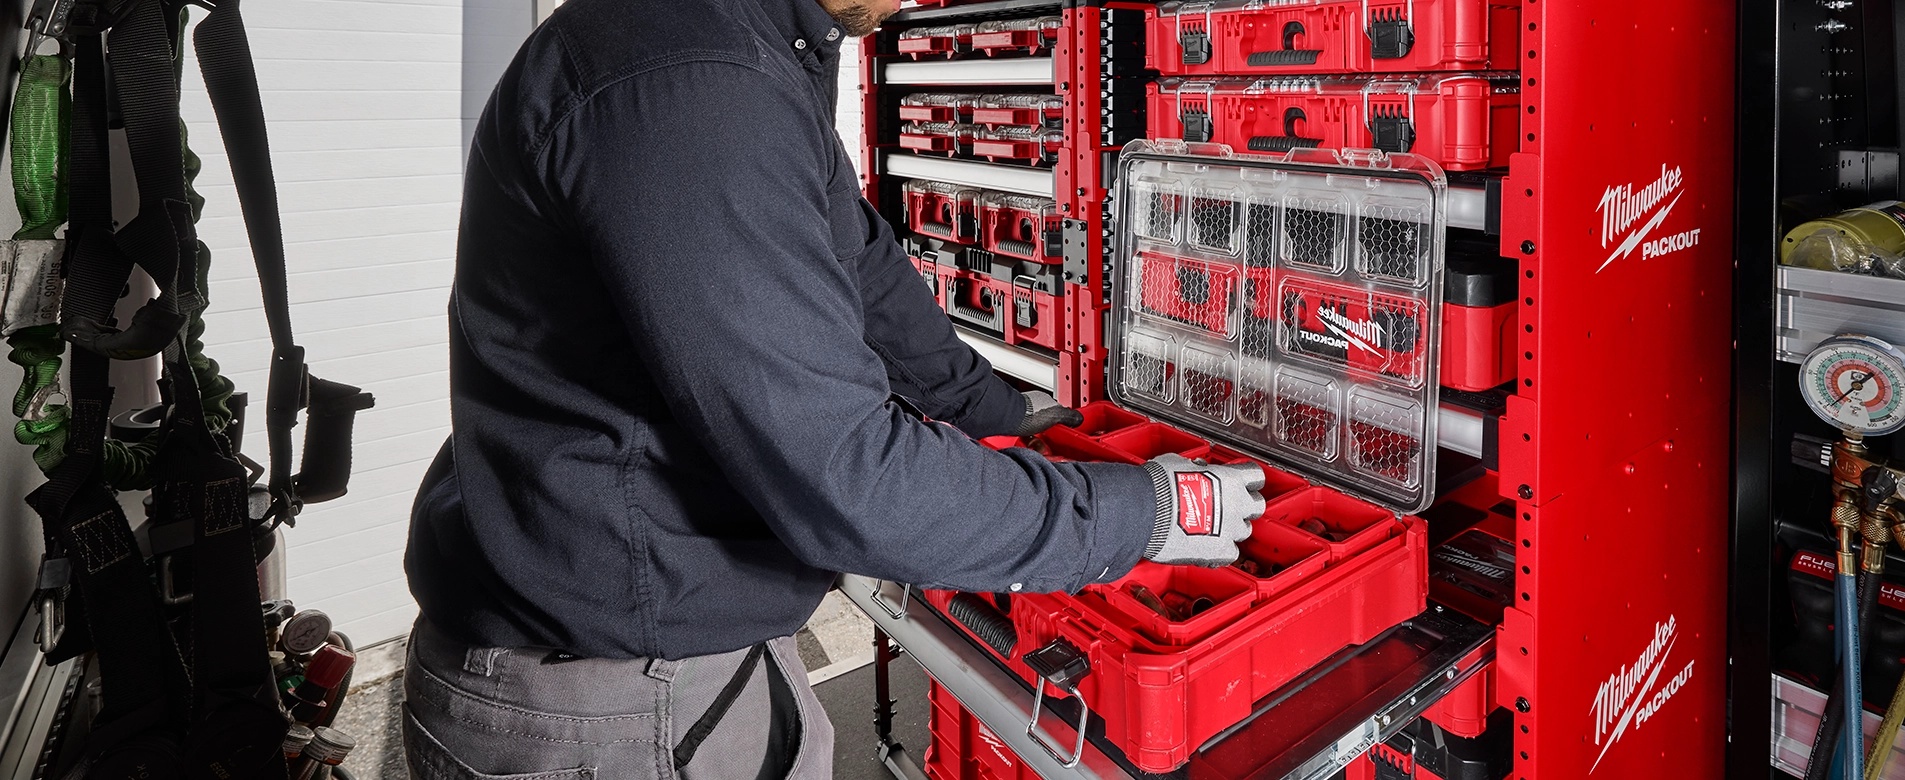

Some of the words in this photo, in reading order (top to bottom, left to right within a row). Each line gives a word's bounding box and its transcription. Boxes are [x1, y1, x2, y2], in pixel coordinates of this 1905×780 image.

[1595, 163, 1683, 249] Milwaukee
[1642, 228, 1701, 260] PACKOUT
[1180, 484, 1198, 529] Milwaukee
[1441, 543, 1479, 560] PACKO
[1798, 561, 1833, 574] BRUSHLE
[1800, 554, 1835, 570] FUE
[1881, 585, 1905, 598] UE
[1589, 614, 1677, 745] Milwaukee
[1635, 659, 1695, 730] PACKOUT
